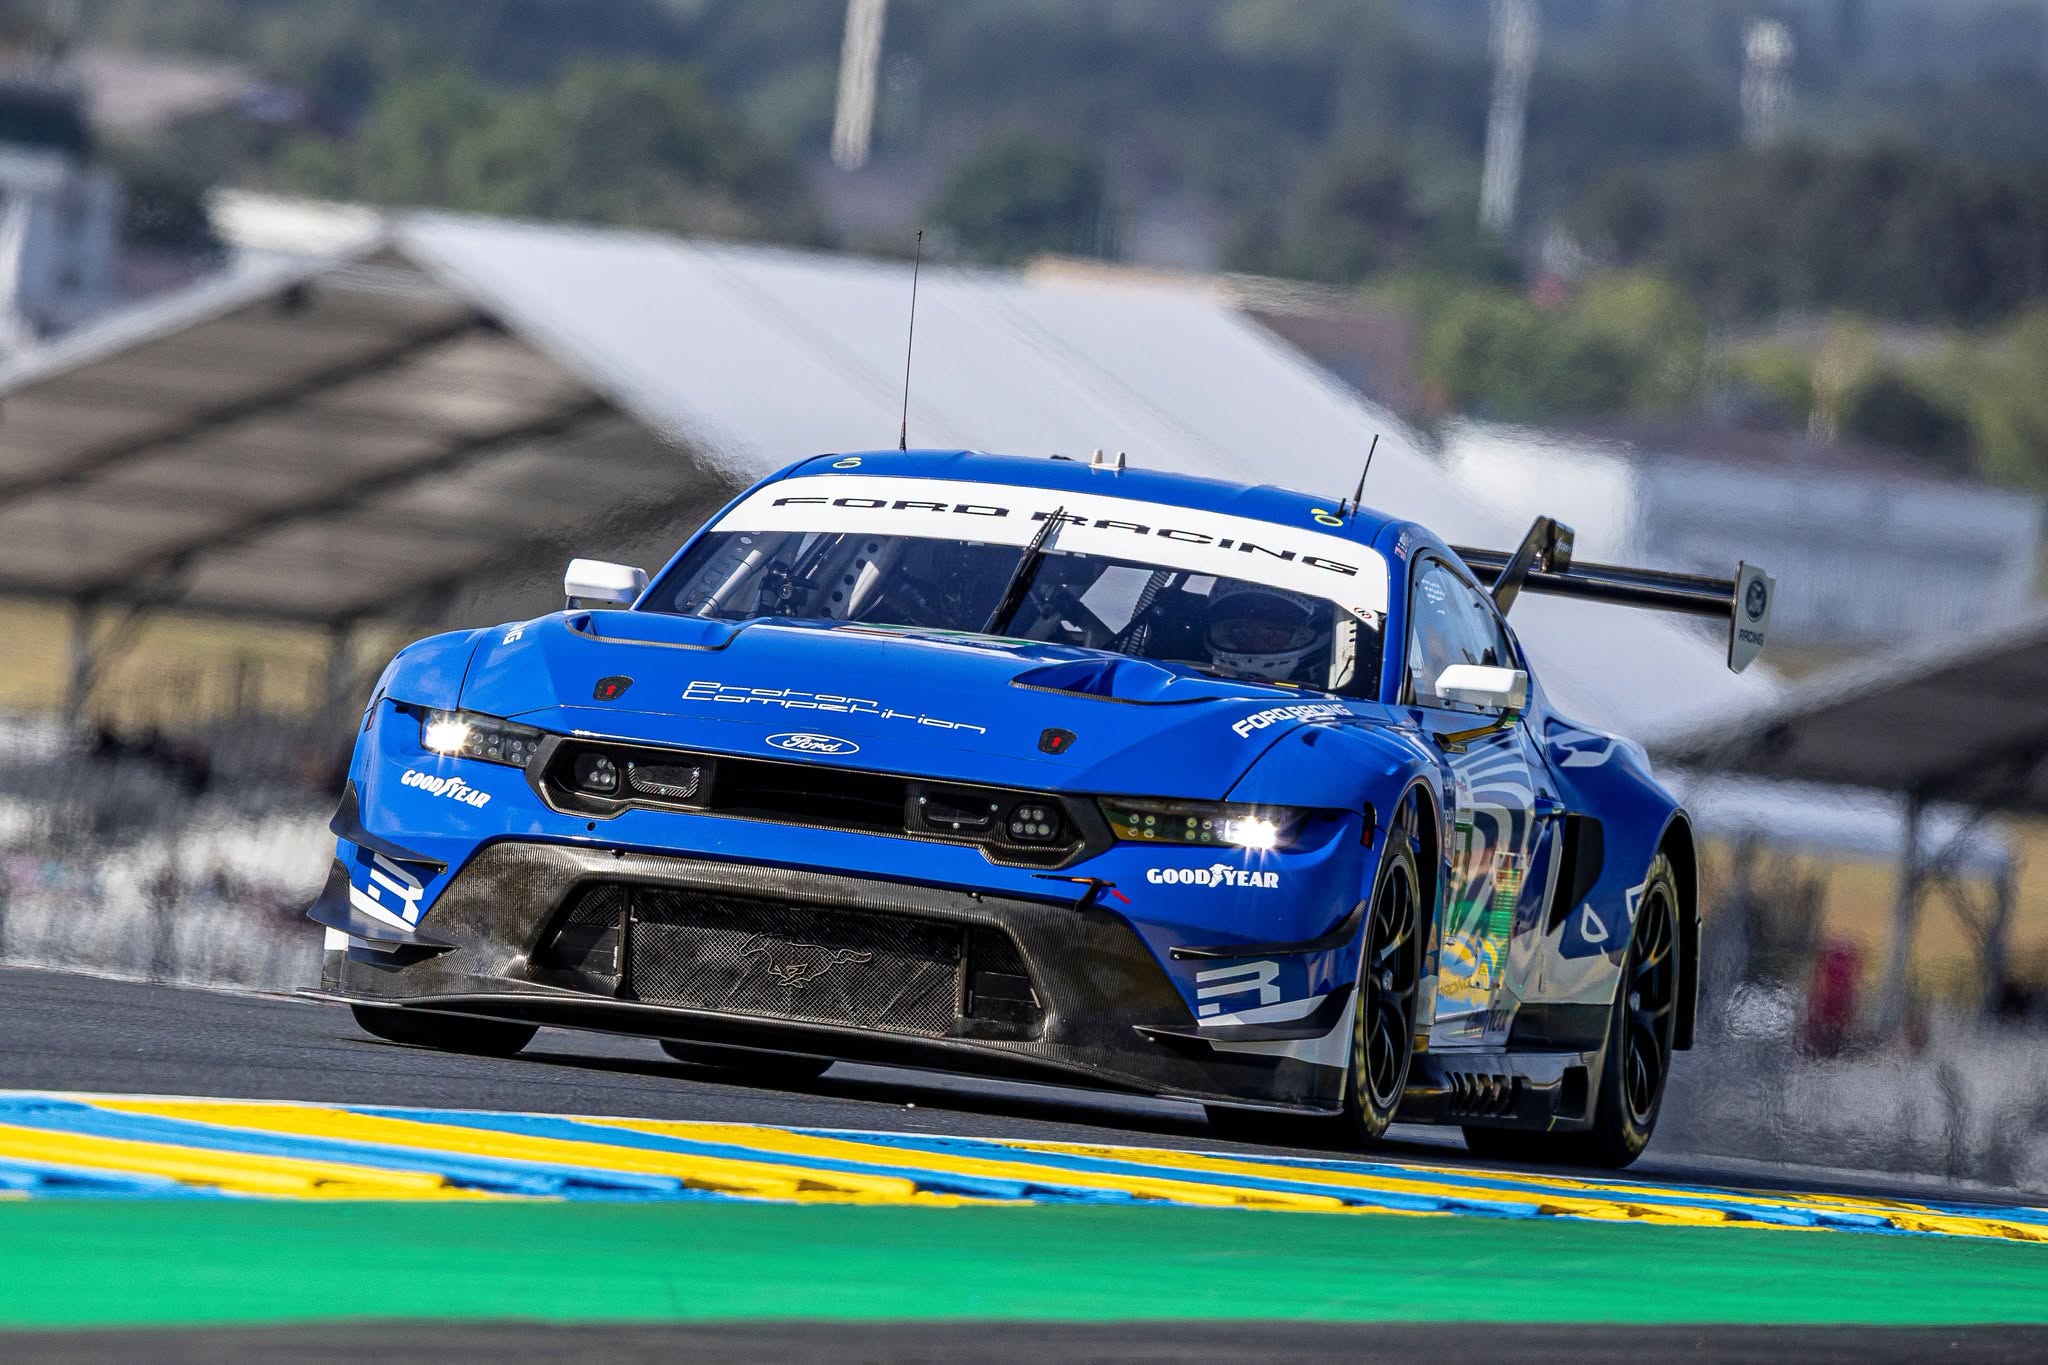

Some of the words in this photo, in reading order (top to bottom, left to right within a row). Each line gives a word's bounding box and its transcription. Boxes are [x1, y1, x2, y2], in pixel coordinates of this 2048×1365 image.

[771, 497, 1010, 518] FORD
[1030, 510, 1360, 577] RACING
[688, 680, 879, 707] Proton
[681, 688, 987, 735] Competition
[782, 734, 843, 753] Ford
[400, 769, 492, 809] GOODYEAR
[1146, 862, 1280, 889] GOODYEAR
